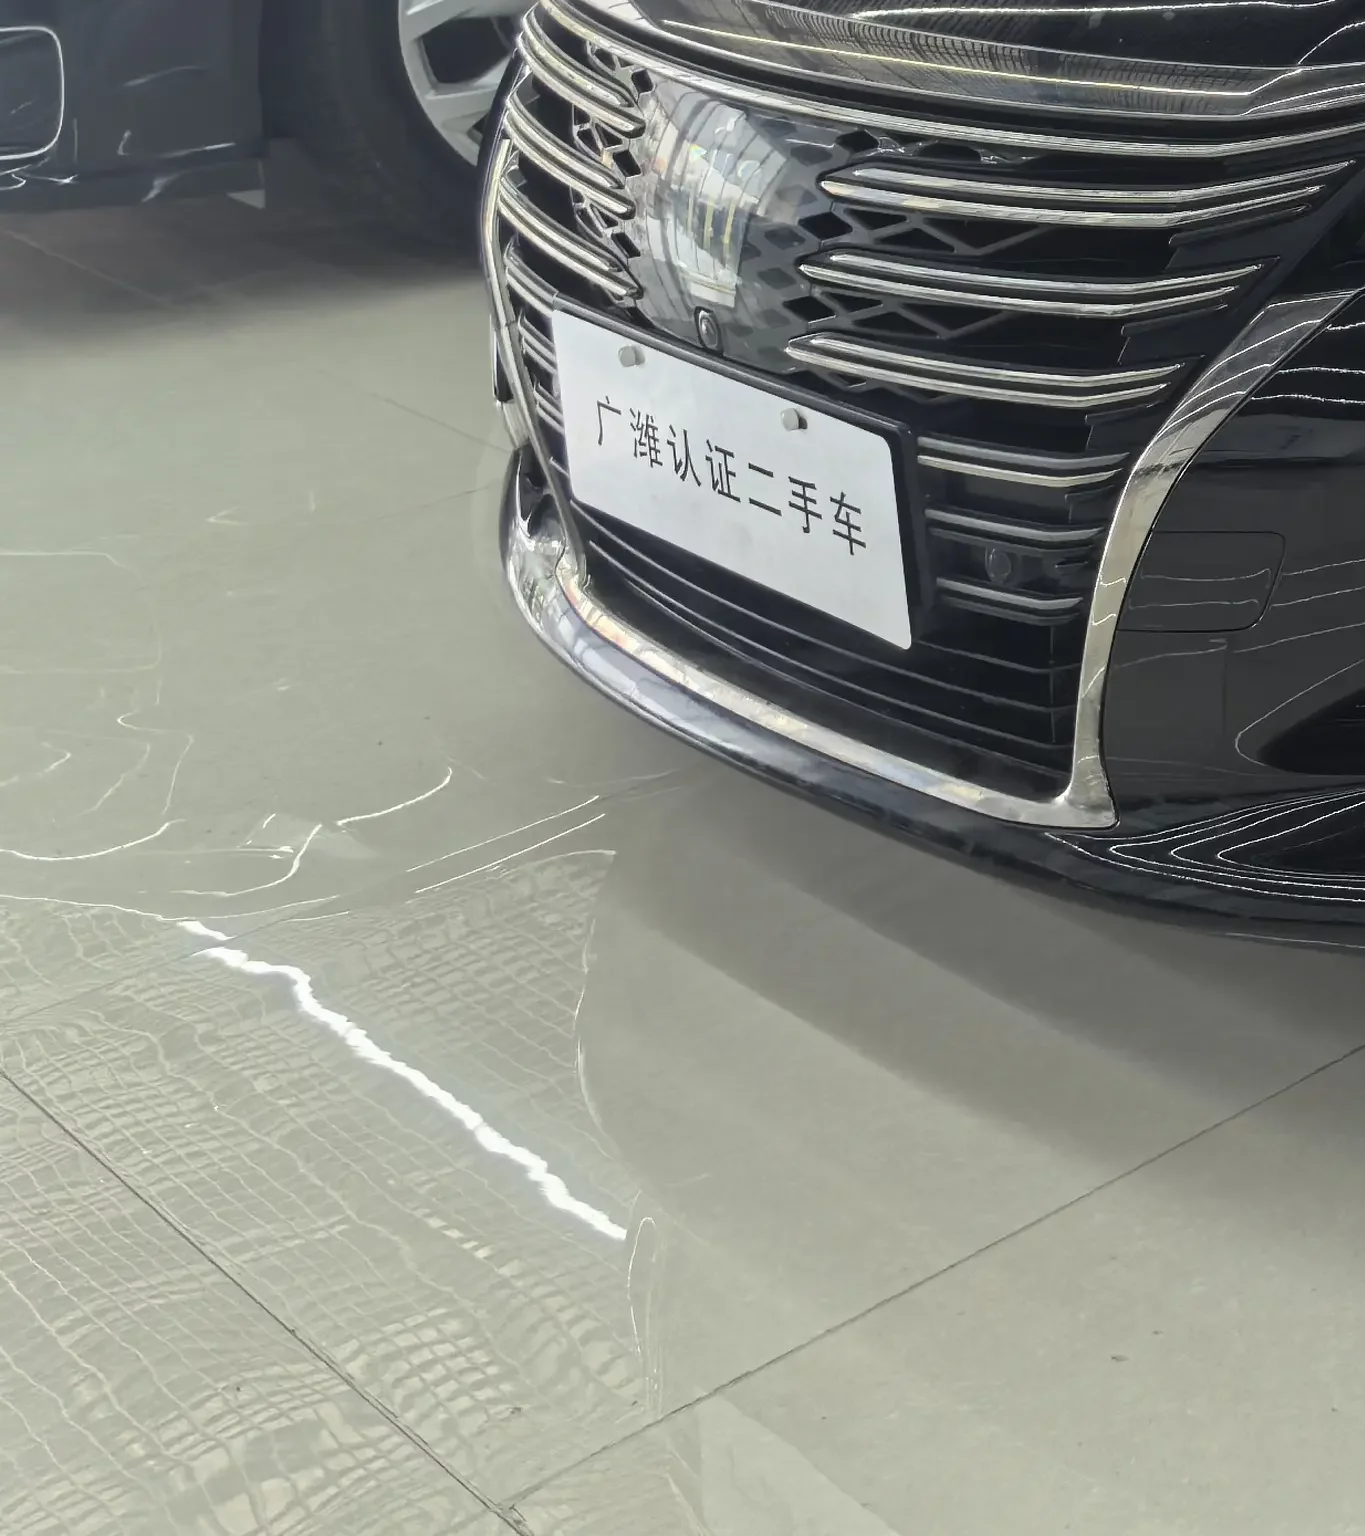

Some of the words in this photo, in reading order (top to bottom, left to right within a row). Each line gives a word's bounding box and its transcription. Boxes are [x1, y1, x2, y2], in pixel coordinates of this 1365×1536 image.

[595, 395, 868, 557] 广潍认证二手车
